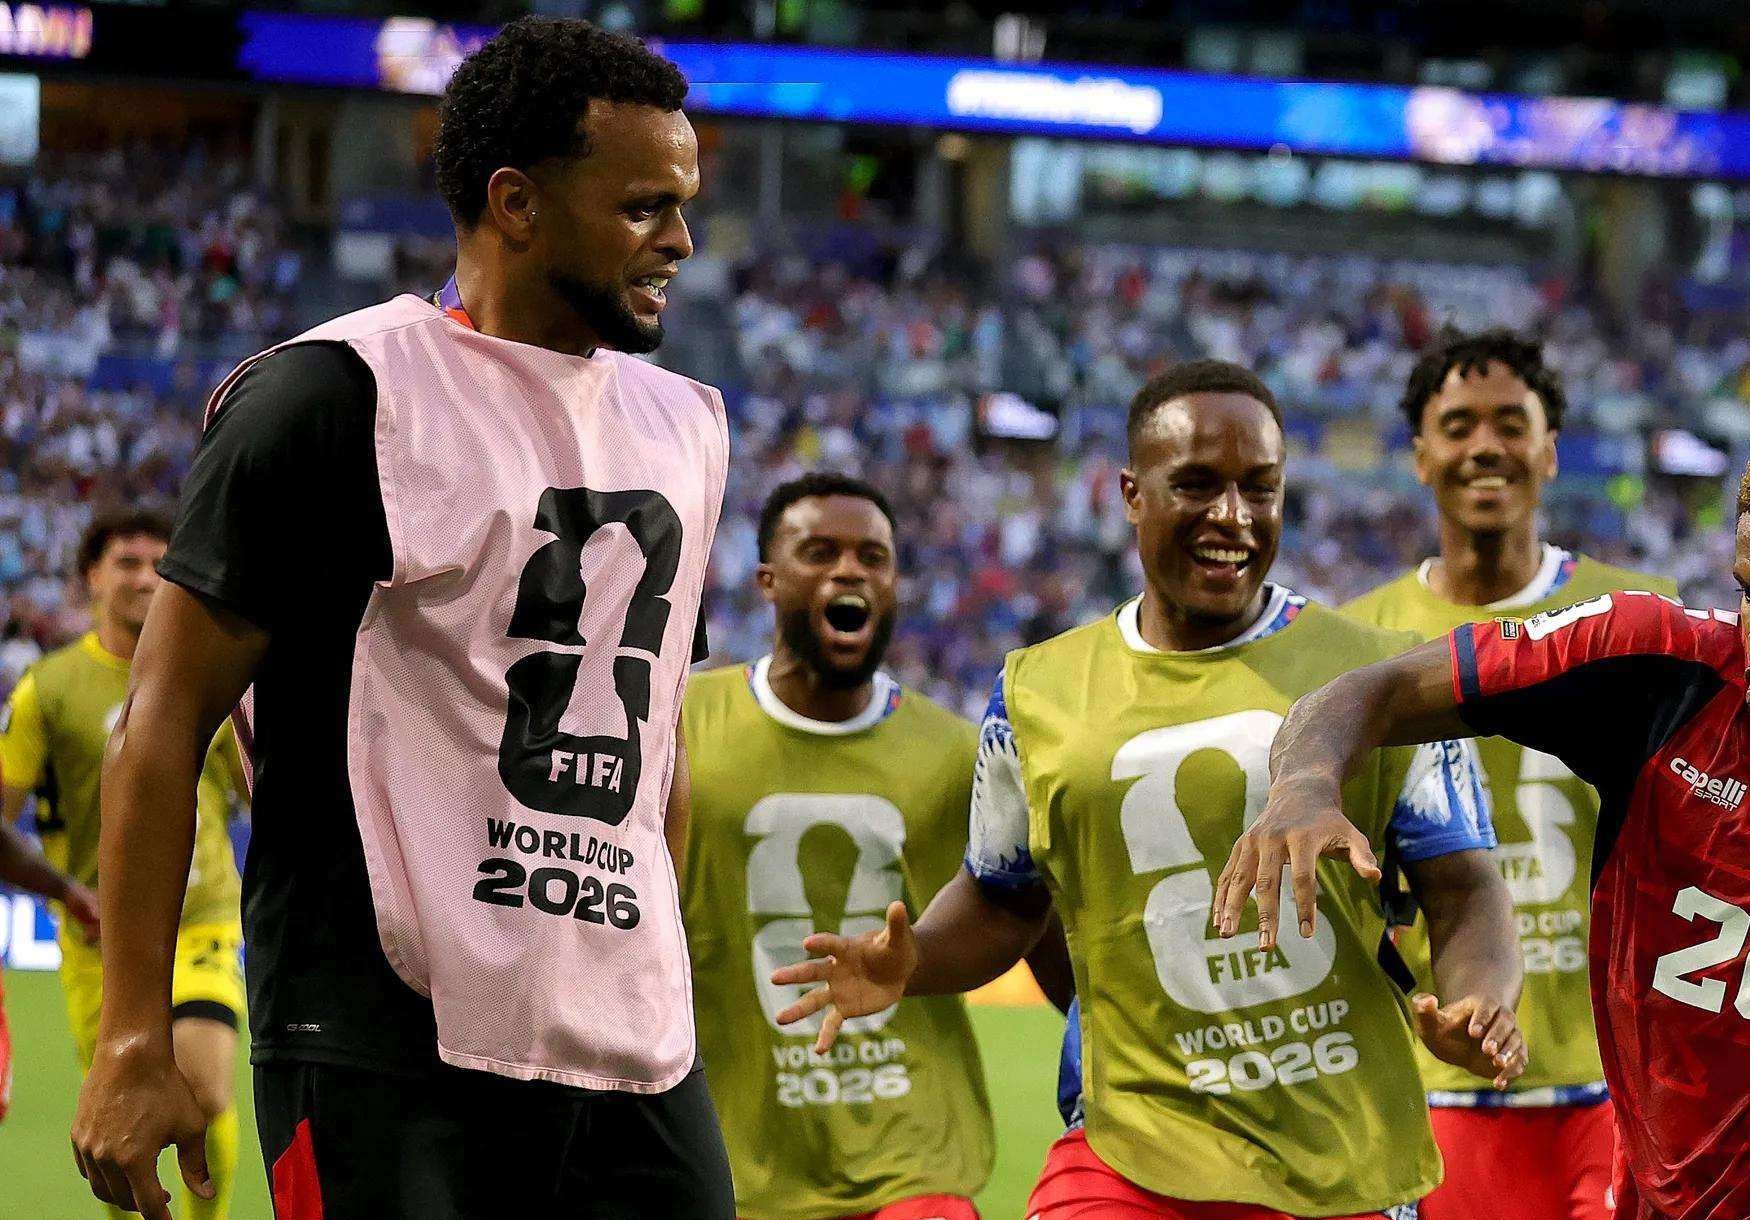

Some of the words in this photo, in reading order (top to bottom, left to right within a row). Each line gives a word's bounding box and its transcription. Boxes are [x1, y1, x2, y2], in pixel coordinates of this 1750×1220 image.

[548, 749, 624, 794] FIFA
[1670, 757, 1748, 806] capelli
[1694, 788, 1738, 812] SPORT
[487, 817, 599, 865] WORLD
[597, 841, 634, 875] CUP
[472, 857, 641, 931] 2026
[1207, 945, 1291, 984] FIFA
[1175, 1014, 1285, 1056] WORLD
[1290, 999, 1350, 1035] CUP
[776, 1063, 912, 1108] 2026
[1186, 1031, 1360, 1096] 2026
